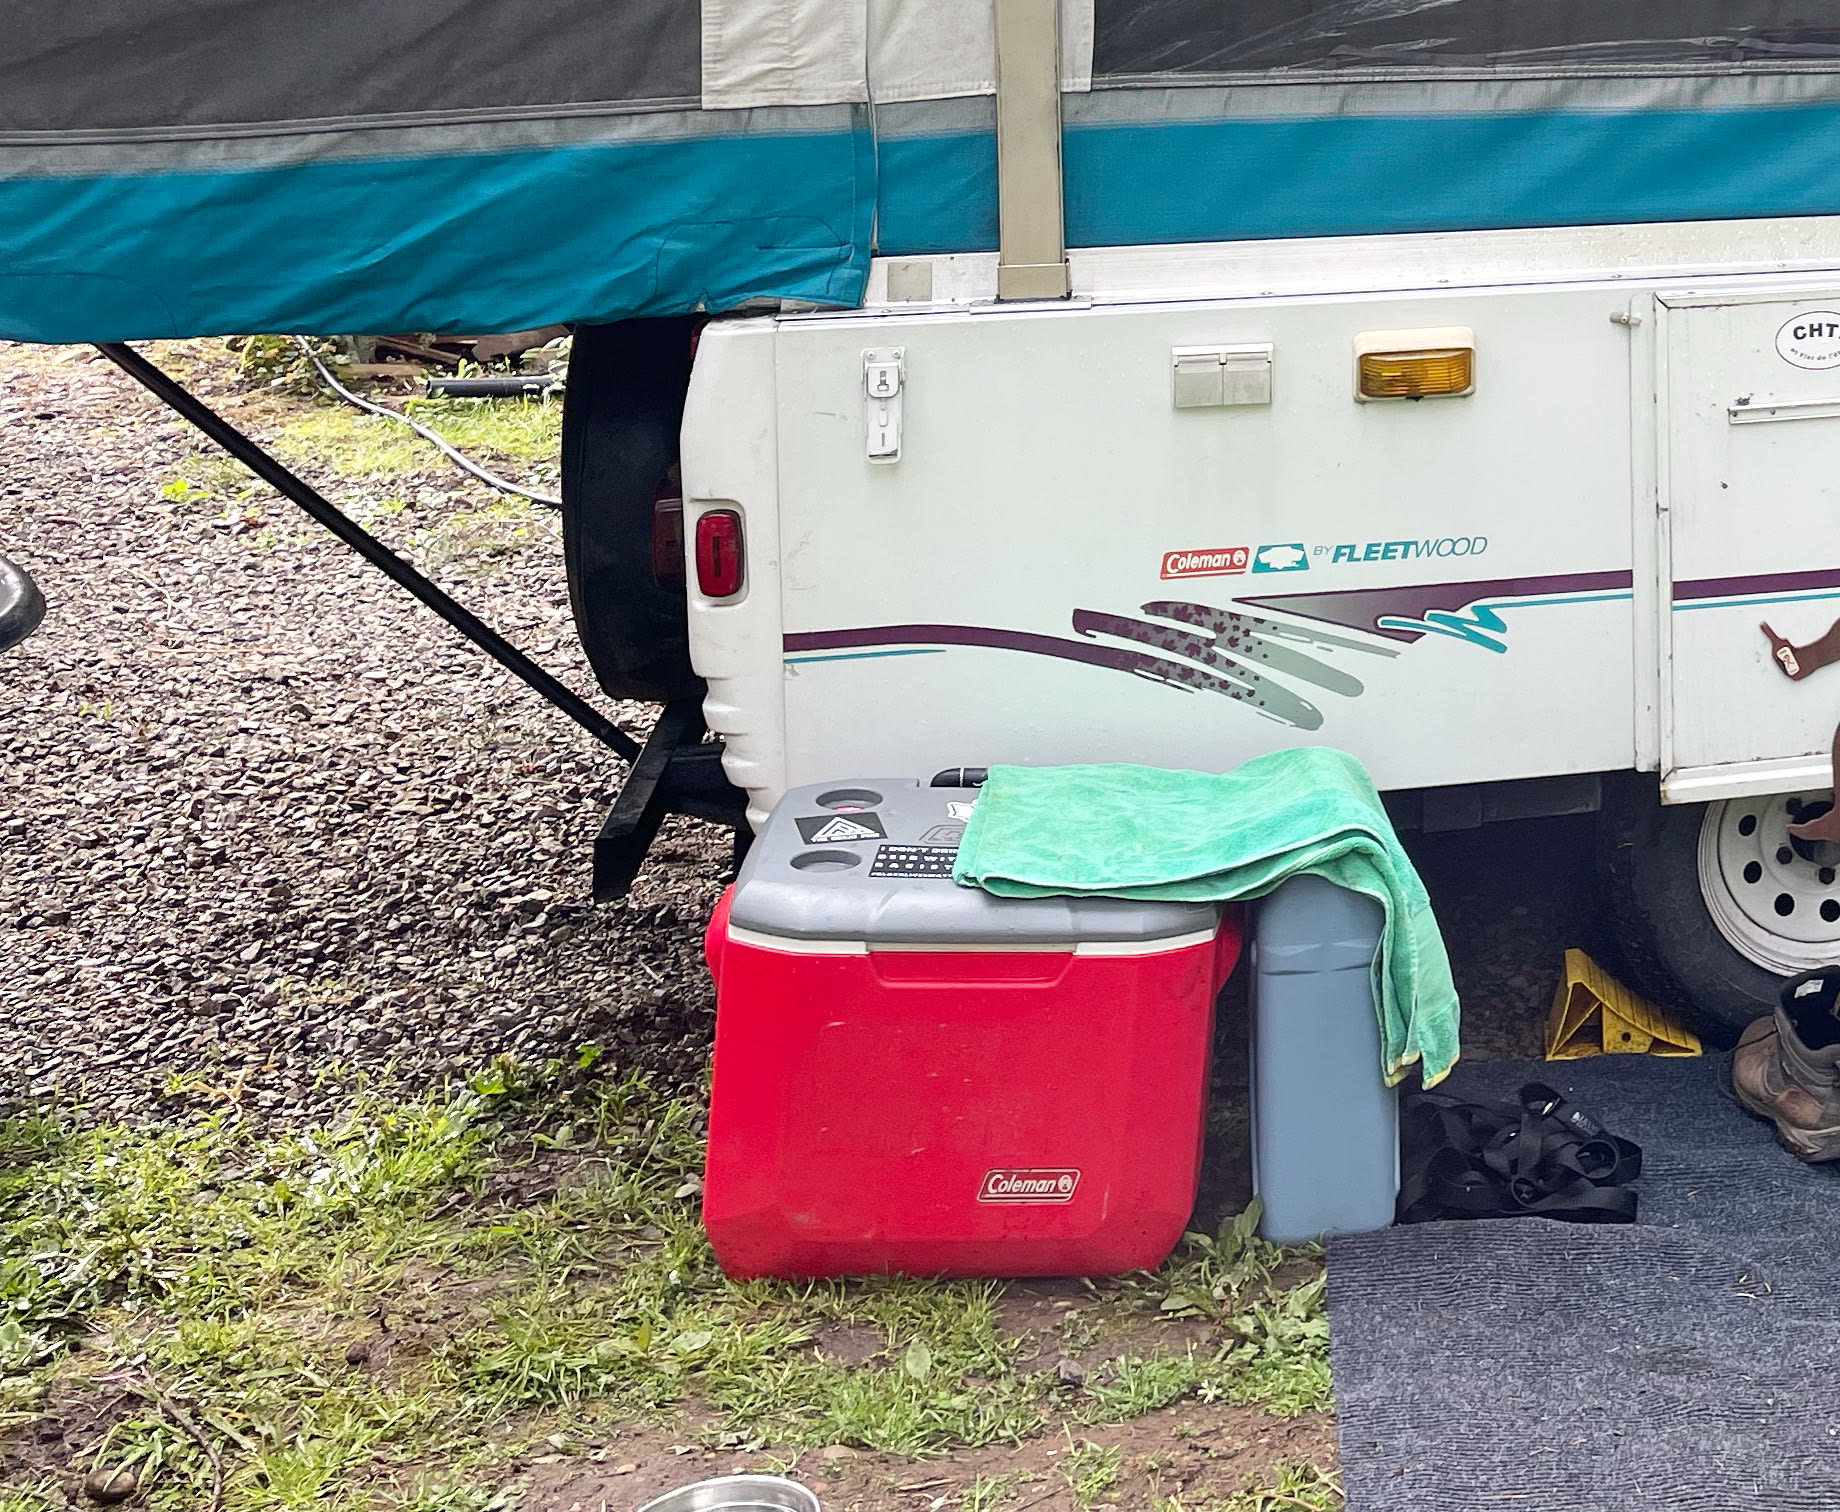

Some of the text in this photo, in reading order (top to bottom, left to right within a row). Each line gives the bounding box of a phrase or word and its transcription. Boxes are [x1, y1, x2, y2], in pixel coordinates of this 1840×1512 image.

[1166, 536, 1488, 574] Coleman BY FLEETWOOD
[874, 862, 953, 871] RACIST
[987, 1173, 1057, 1194] Coleman
